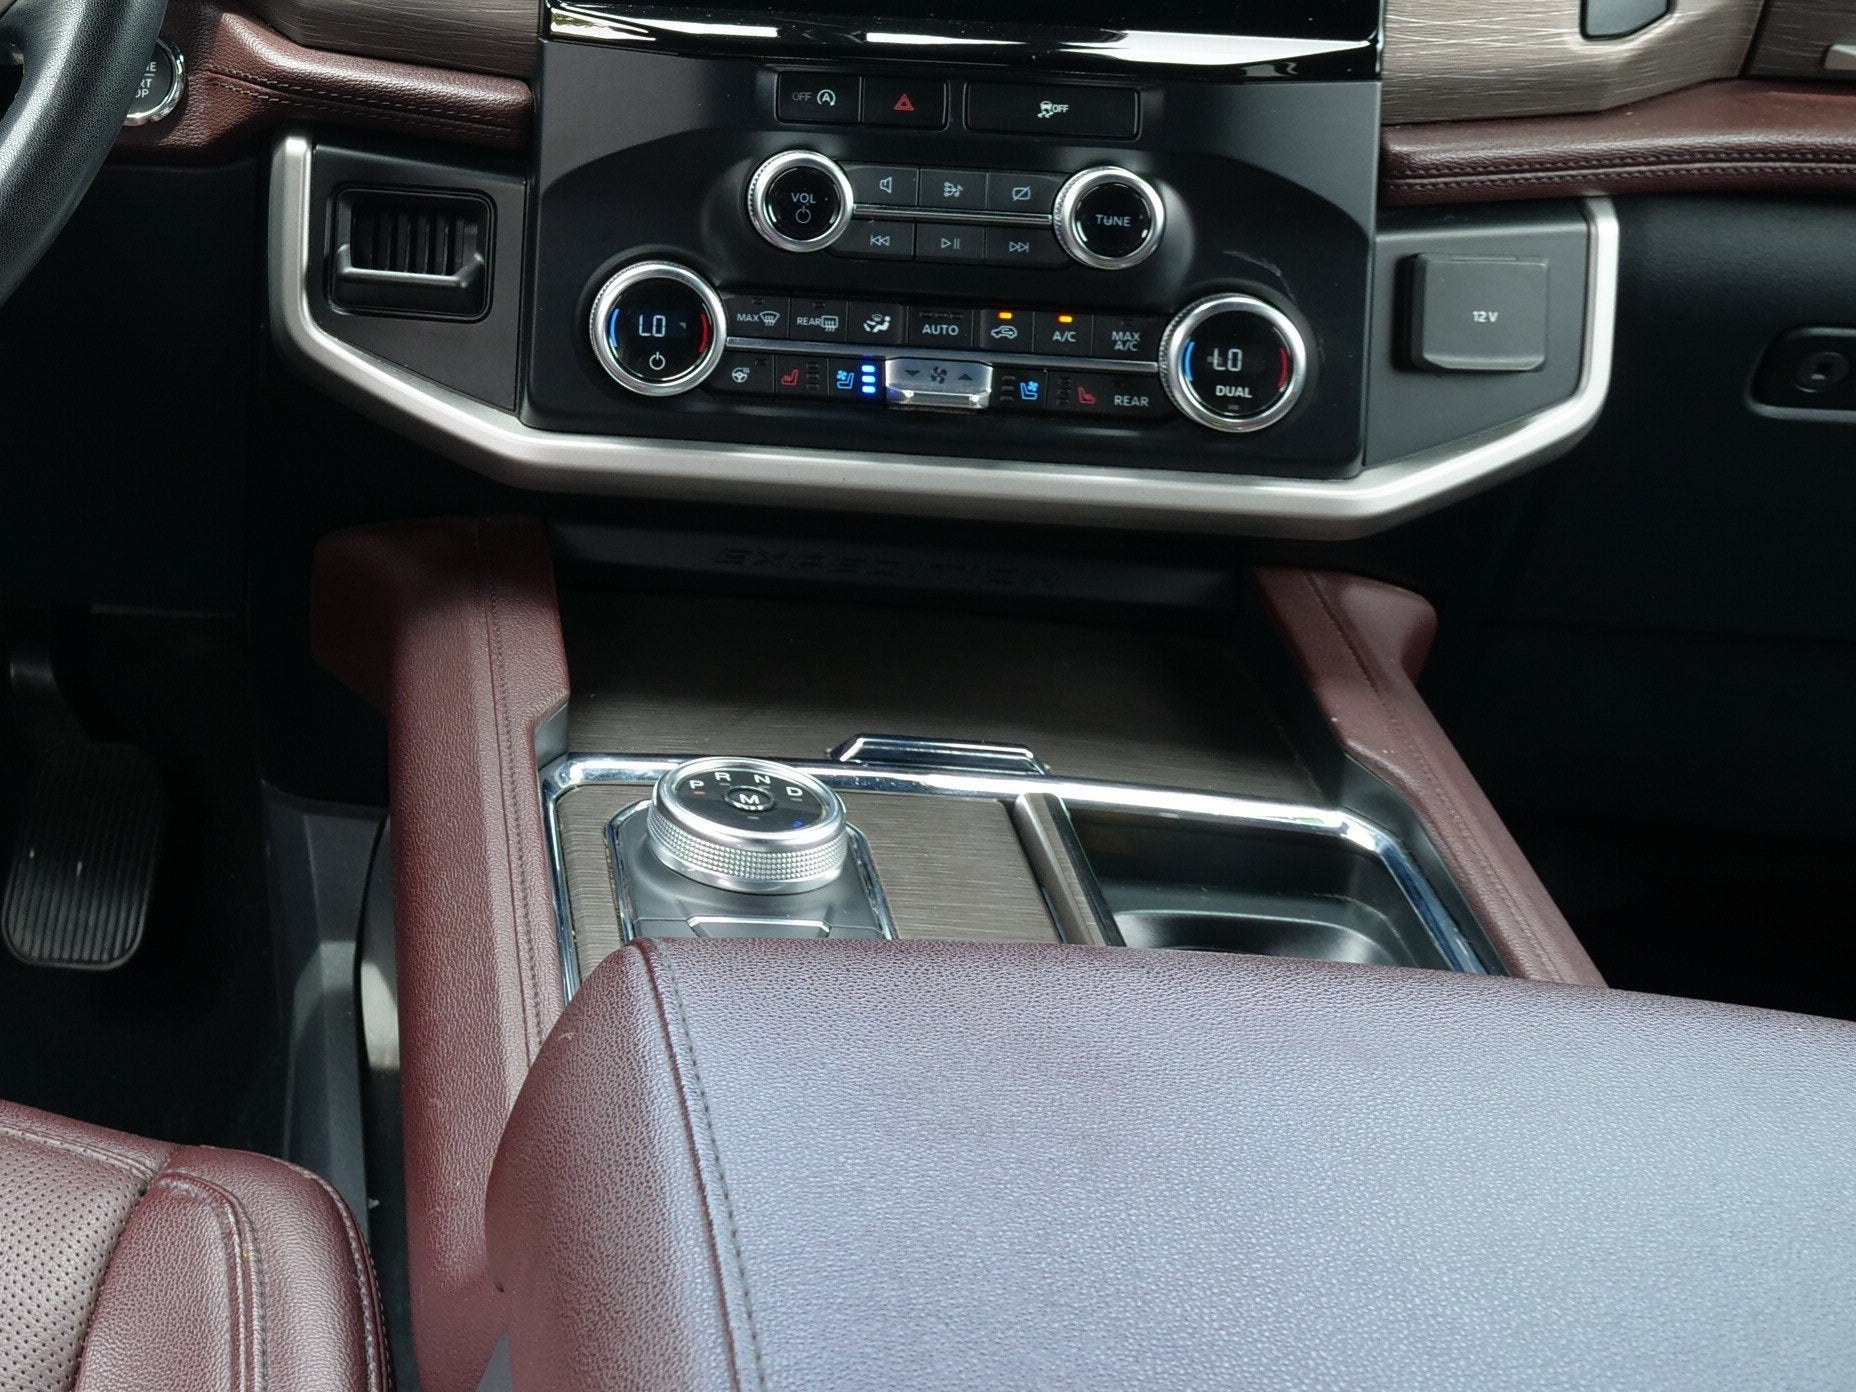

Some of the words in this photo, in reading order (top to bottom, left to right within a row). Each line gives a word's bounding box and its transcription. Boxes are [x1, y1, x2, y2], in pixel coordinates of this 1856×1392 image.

[792, 92, 812, 102] OFF
[1053, 103, 1069, 114] OFF
[791, 193, 816, 205] VOL
[1096, 214, 1130, 226] TUNE
[737, 313, 760, 321] MAX
[797, 316, 821, 326] REAR
[1473, 311, 1498, 322] 12V
[922, 325, 958, 335] AUTO
[1112, 330, 1139, 341] MAX
[1053, 331, 1075, 342] A/C
[1114, 341, 1139, 352] A/C
[1216, 385, 1252, 398] DUAL
[1115, 395, 1148, 406] REAR
[714, 771, 731, 782] R
[753, 774, 771, 784] N
[689, 780, 704, 789] P
[786, 786, 803, 796] D
[739, 793, 759, 804] M
